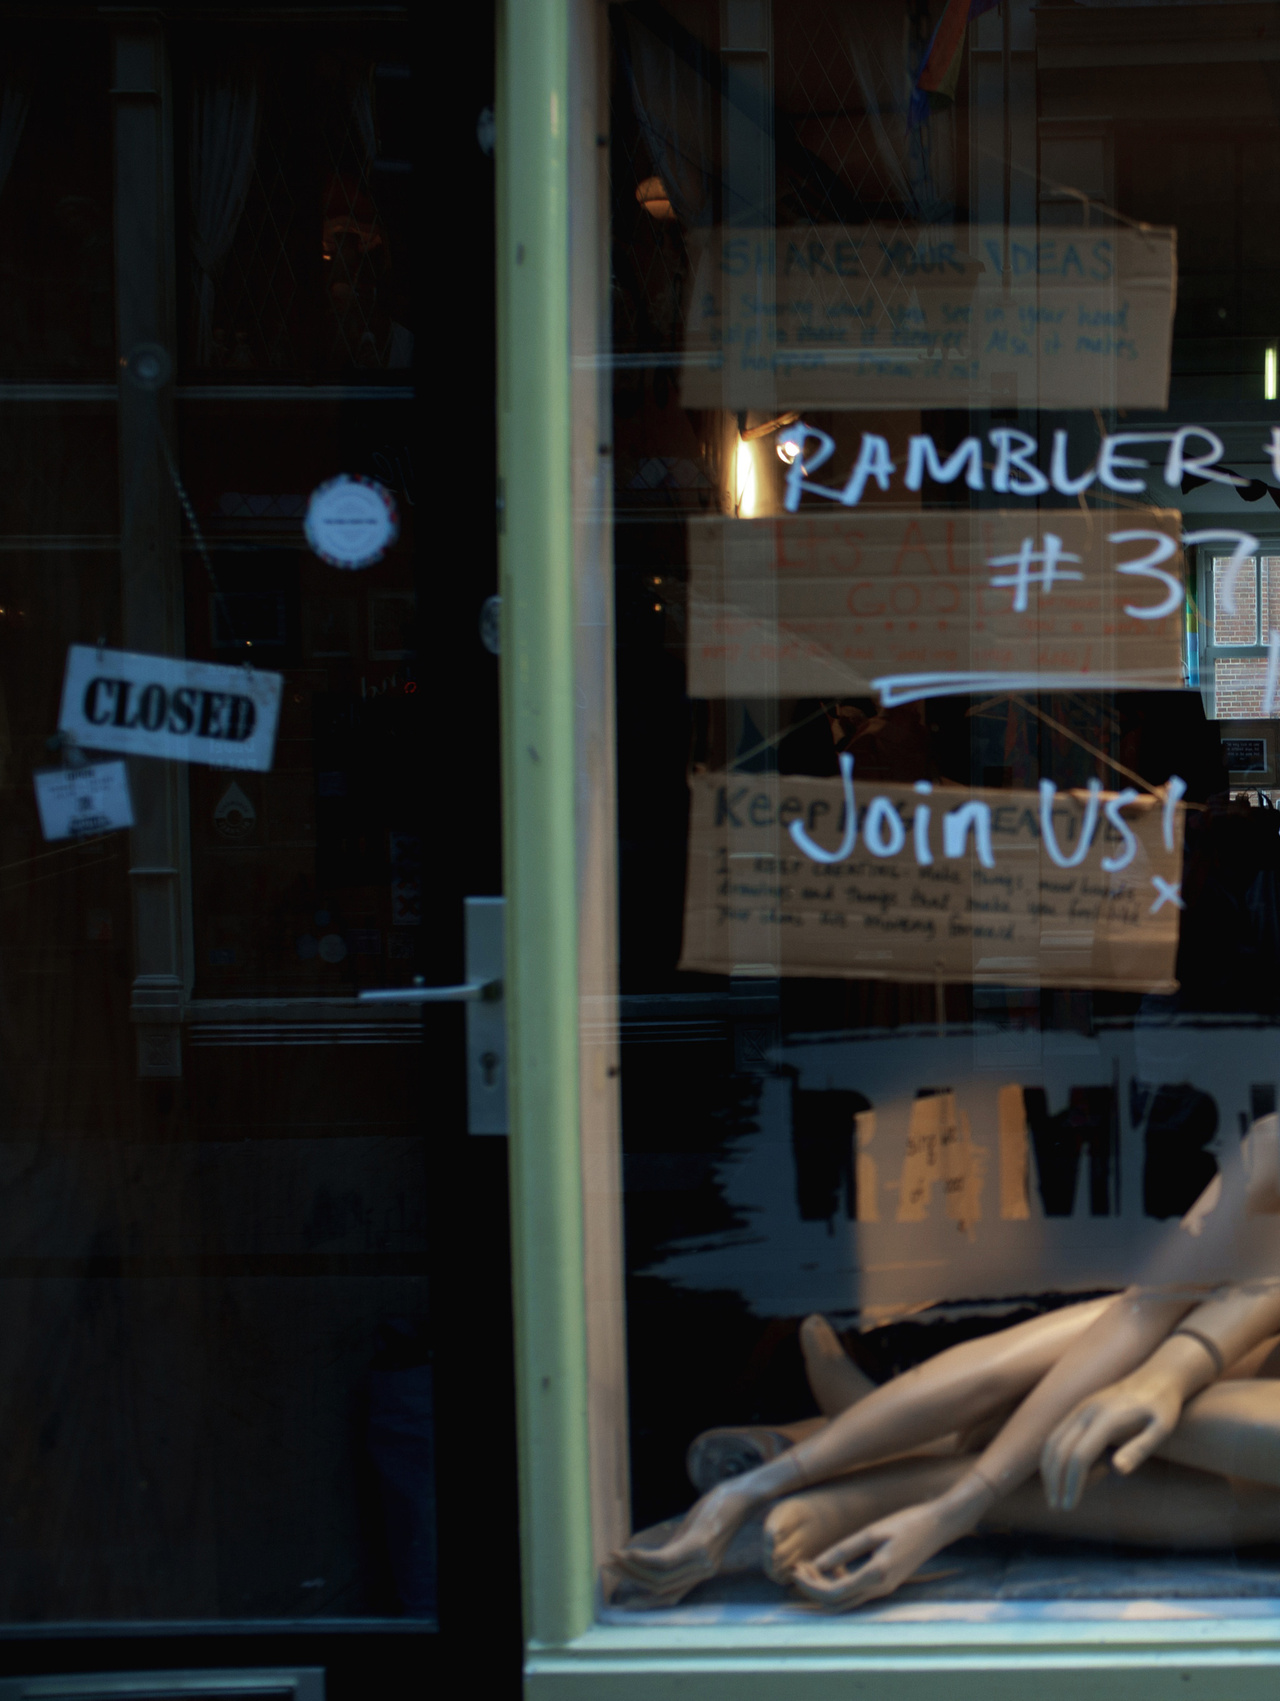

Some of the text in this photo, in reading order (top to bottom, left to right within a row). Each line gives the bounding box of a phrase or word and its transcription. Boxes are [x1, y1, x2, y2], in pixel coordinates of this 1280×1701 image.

[779, 423, 1250, 512] RAMBLER
[84, 675, 257, 743] CLOSED
[788, 751, 996, 869] Join
